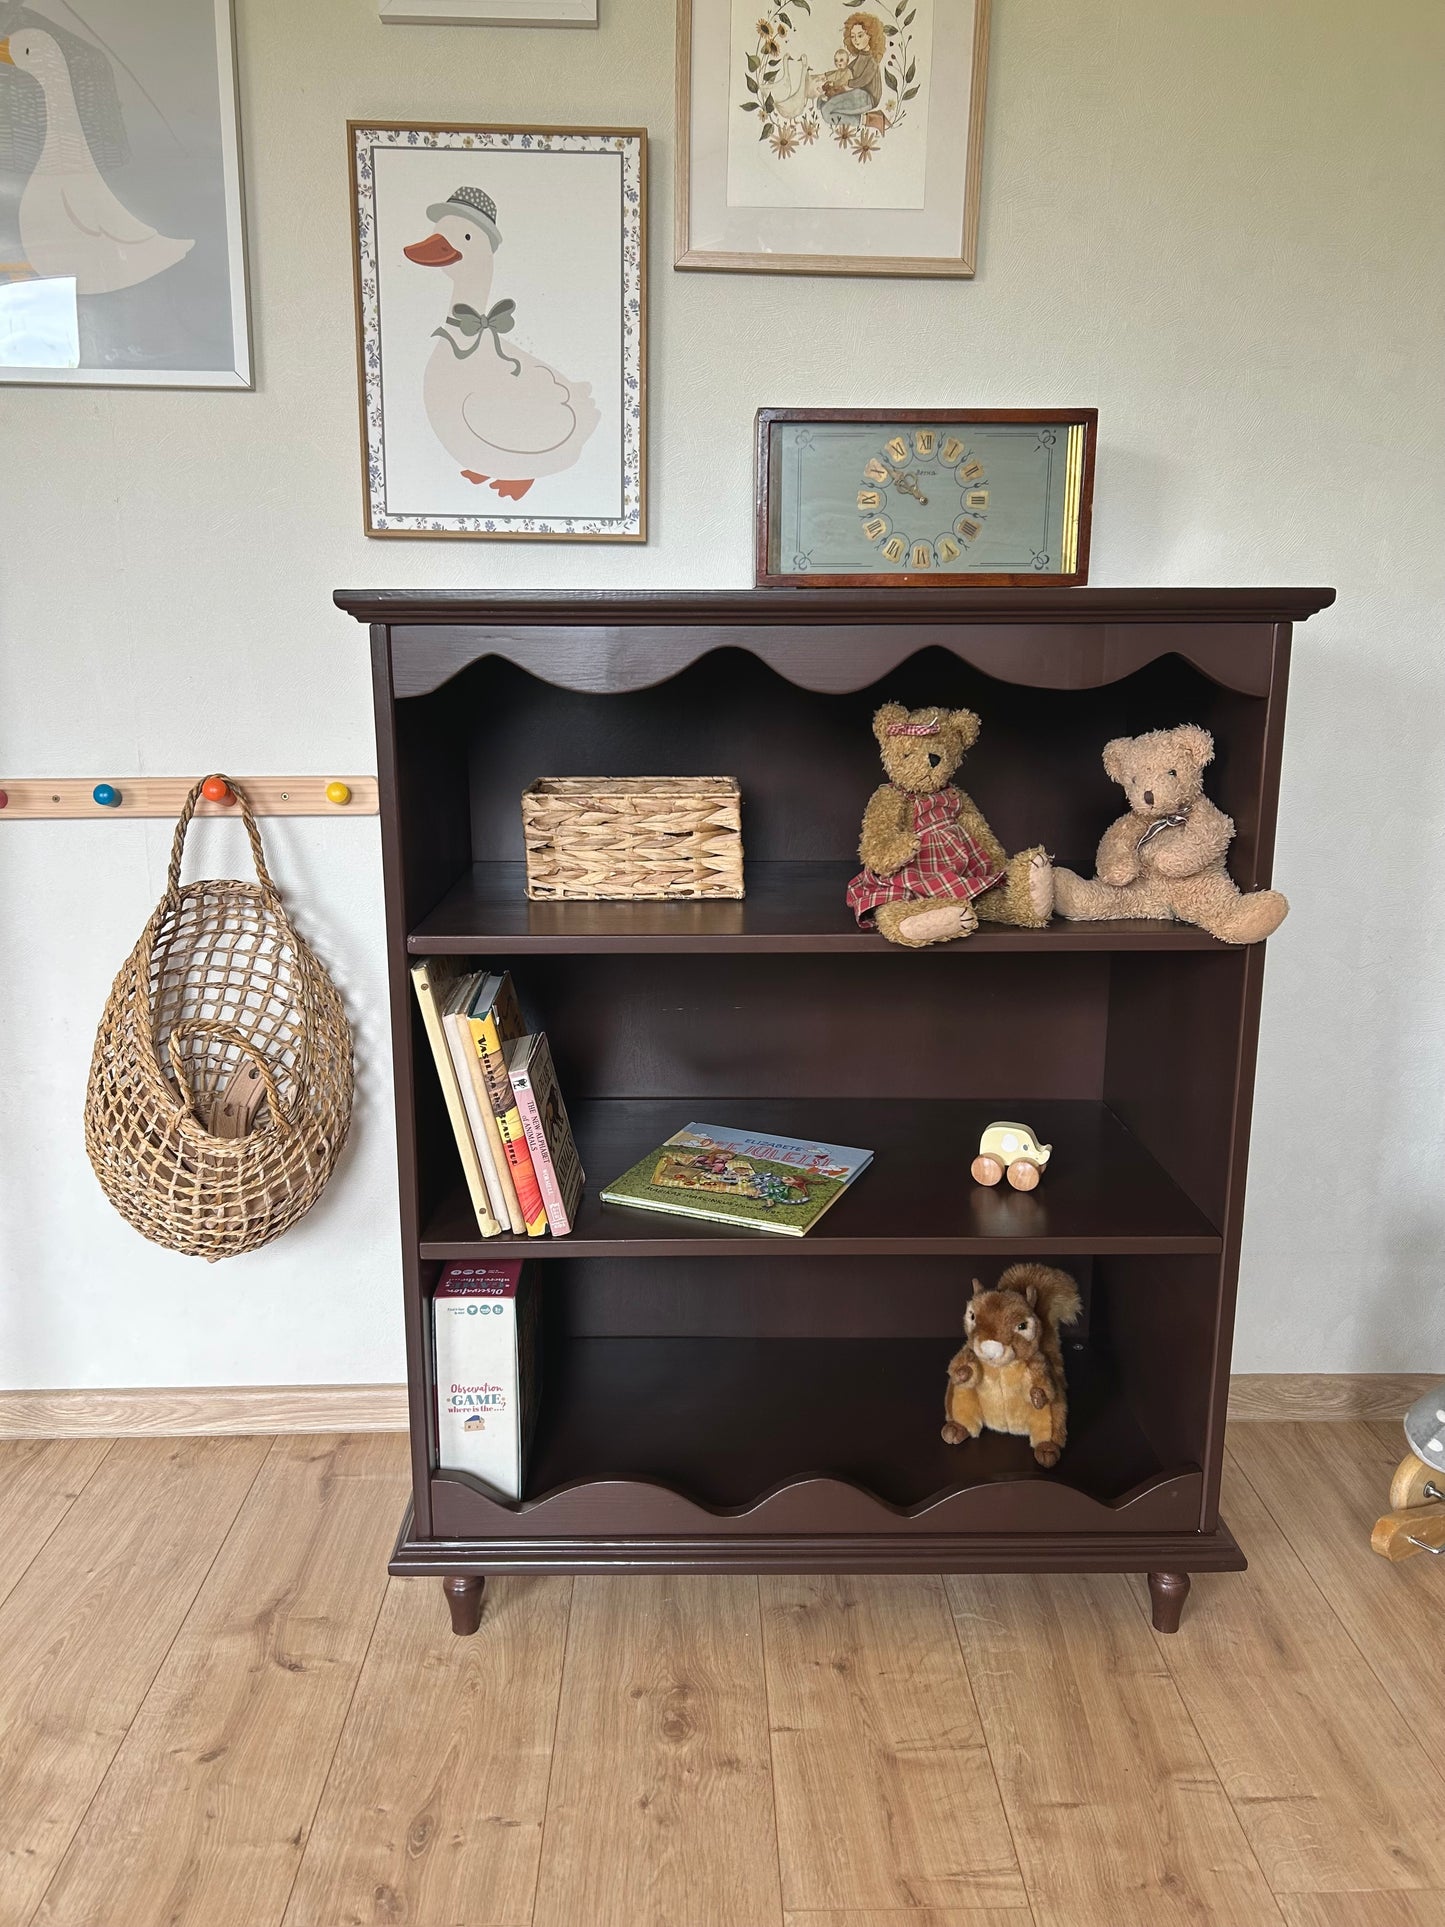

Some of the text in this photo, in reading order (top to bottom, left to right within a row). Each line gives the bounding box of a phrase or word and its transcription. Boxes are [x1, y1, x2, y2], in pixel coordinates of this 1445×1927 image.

[919, 435, 932, 450] XII
[965, 465, 979, 477] II
[971, 496, 986, 505] III
[478, 1034, 496, 1089] VASILISA
[499, 1111, 518, 1166] BEAUTIFUL
[523, 1122, 537, 1152] ANIMALS
[527, 1100, 551, 1164] THE NEW ALPHABET
[744, 1138, 802, 1152] ELIZABETE
[451, 1393, 502, 1406] GAME
